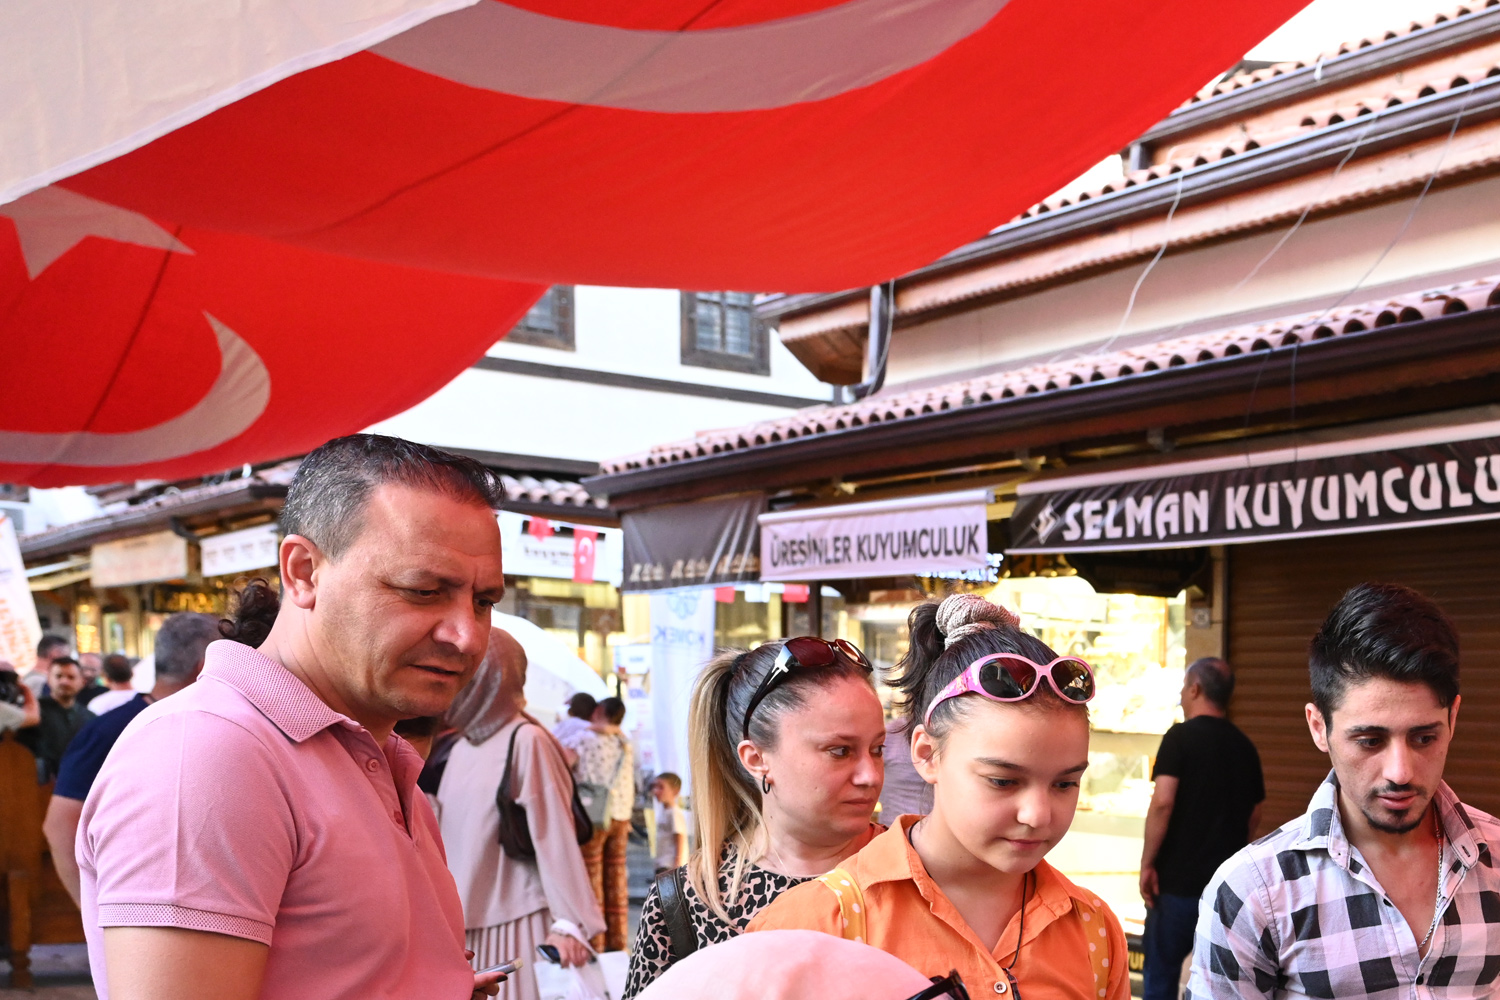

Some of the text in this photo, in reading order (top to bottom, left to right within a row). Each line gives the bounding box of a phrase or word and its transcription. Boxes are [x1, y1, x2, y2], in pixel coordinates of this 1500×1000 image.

[1062, 489, 1209, 542] SELMAN
[770, 532, 852, 568] ÜRESİNLER
[856, 523, 981, 562] KUYUMCULUK
